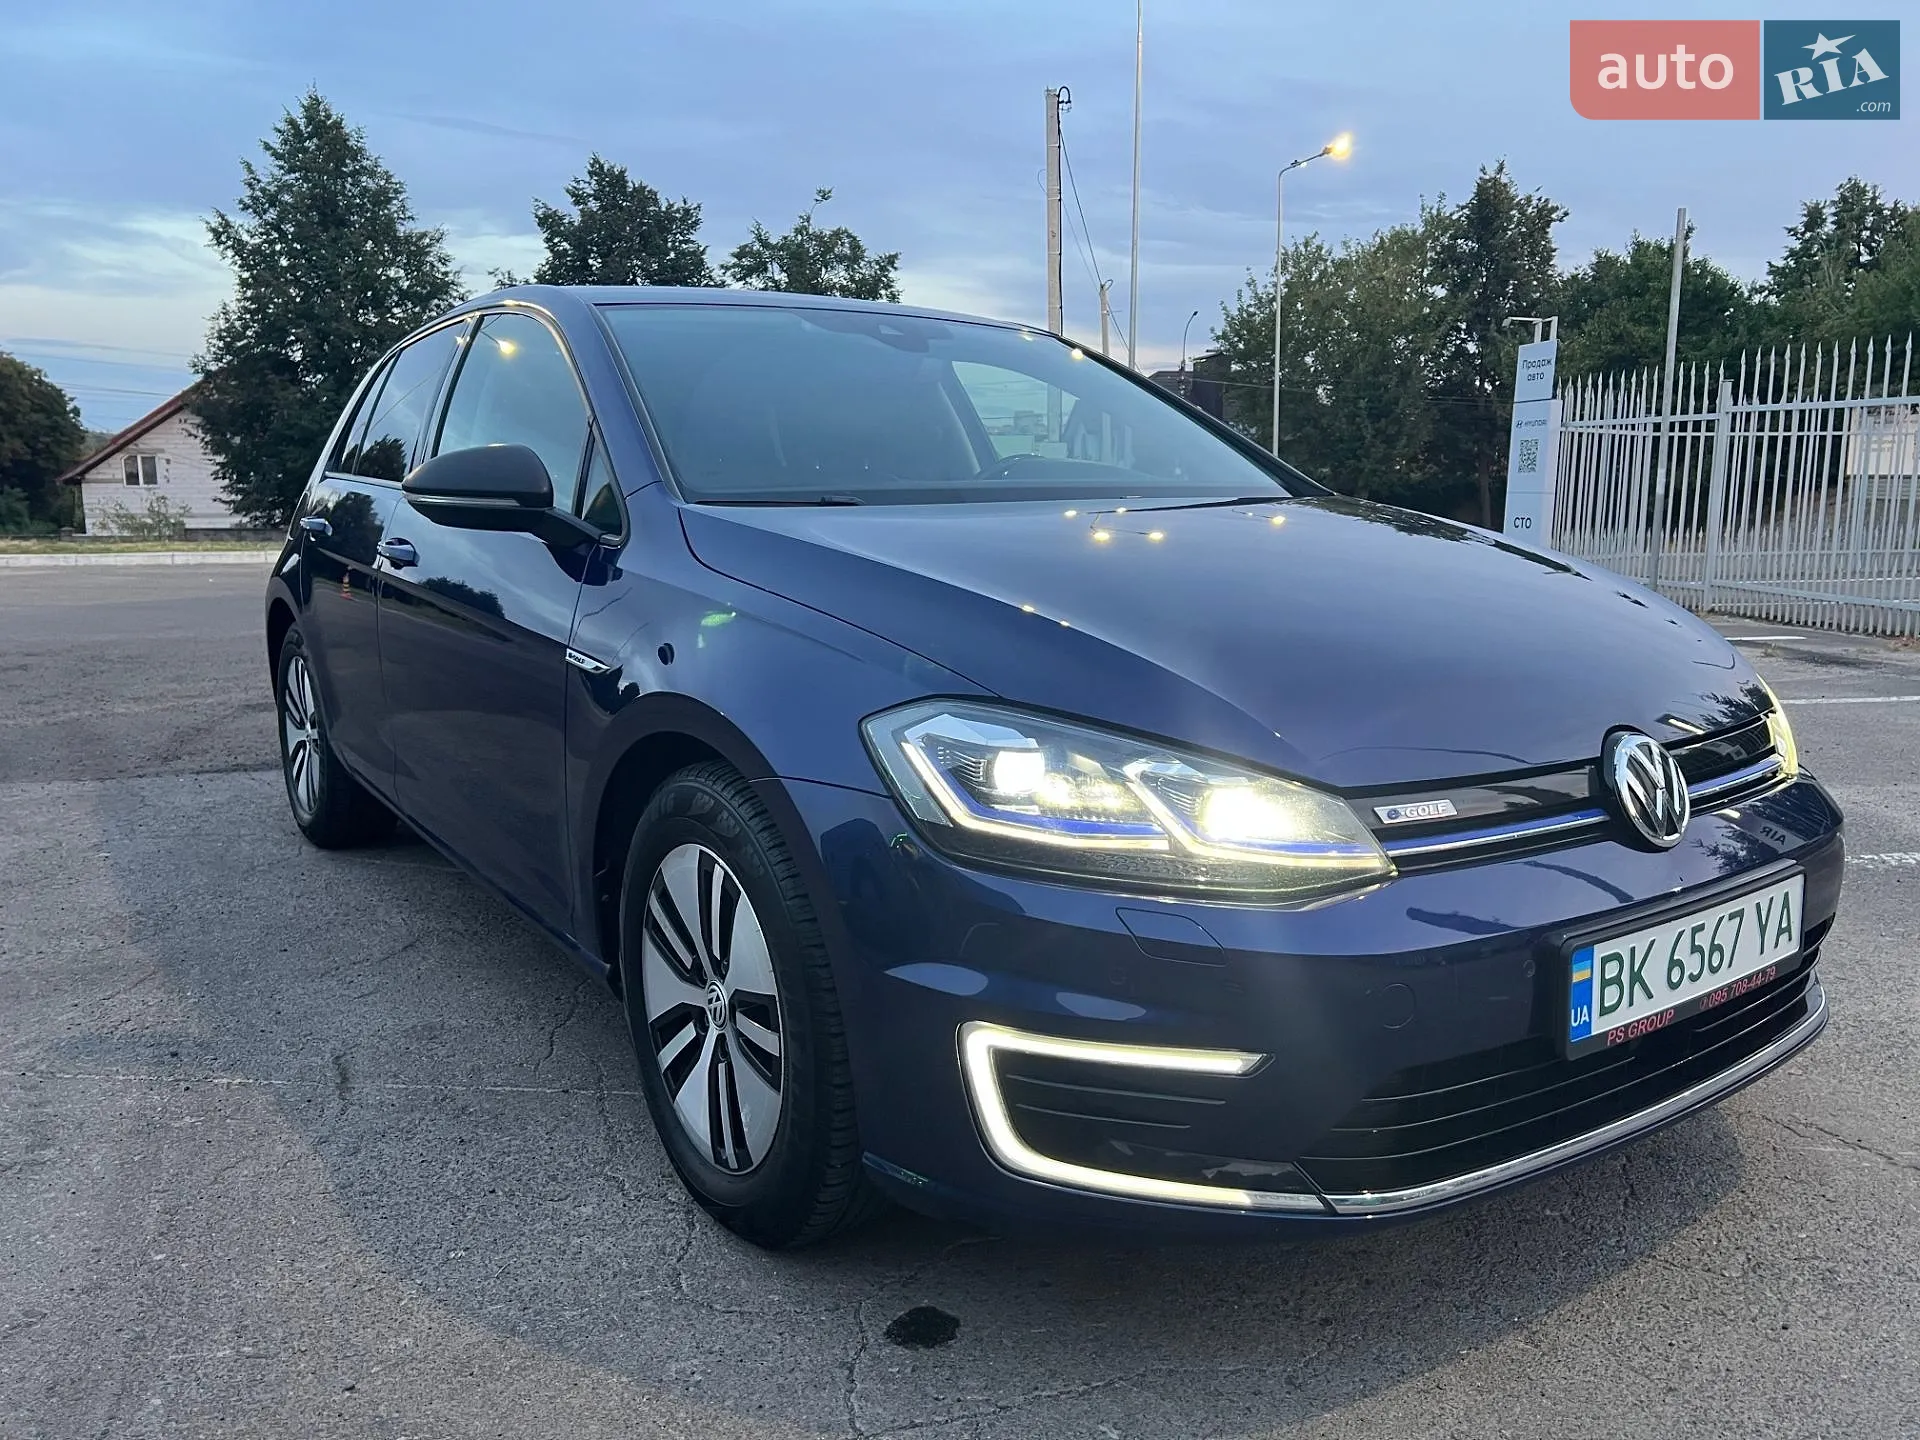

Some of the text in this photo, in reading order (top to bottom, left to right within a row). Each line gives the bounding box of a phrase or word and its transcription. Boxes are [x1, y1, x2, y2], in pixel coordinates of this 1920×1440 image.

[1522, 358, 1553, 370] Продаж
[1527, 372, 1545, 381] авто
[1599, 889, 1793, 1018] BK 6567 YA
[1570, 1006, 1590, 1027] UA
[1607, 1008, 1676, 1046] PS GROUP
